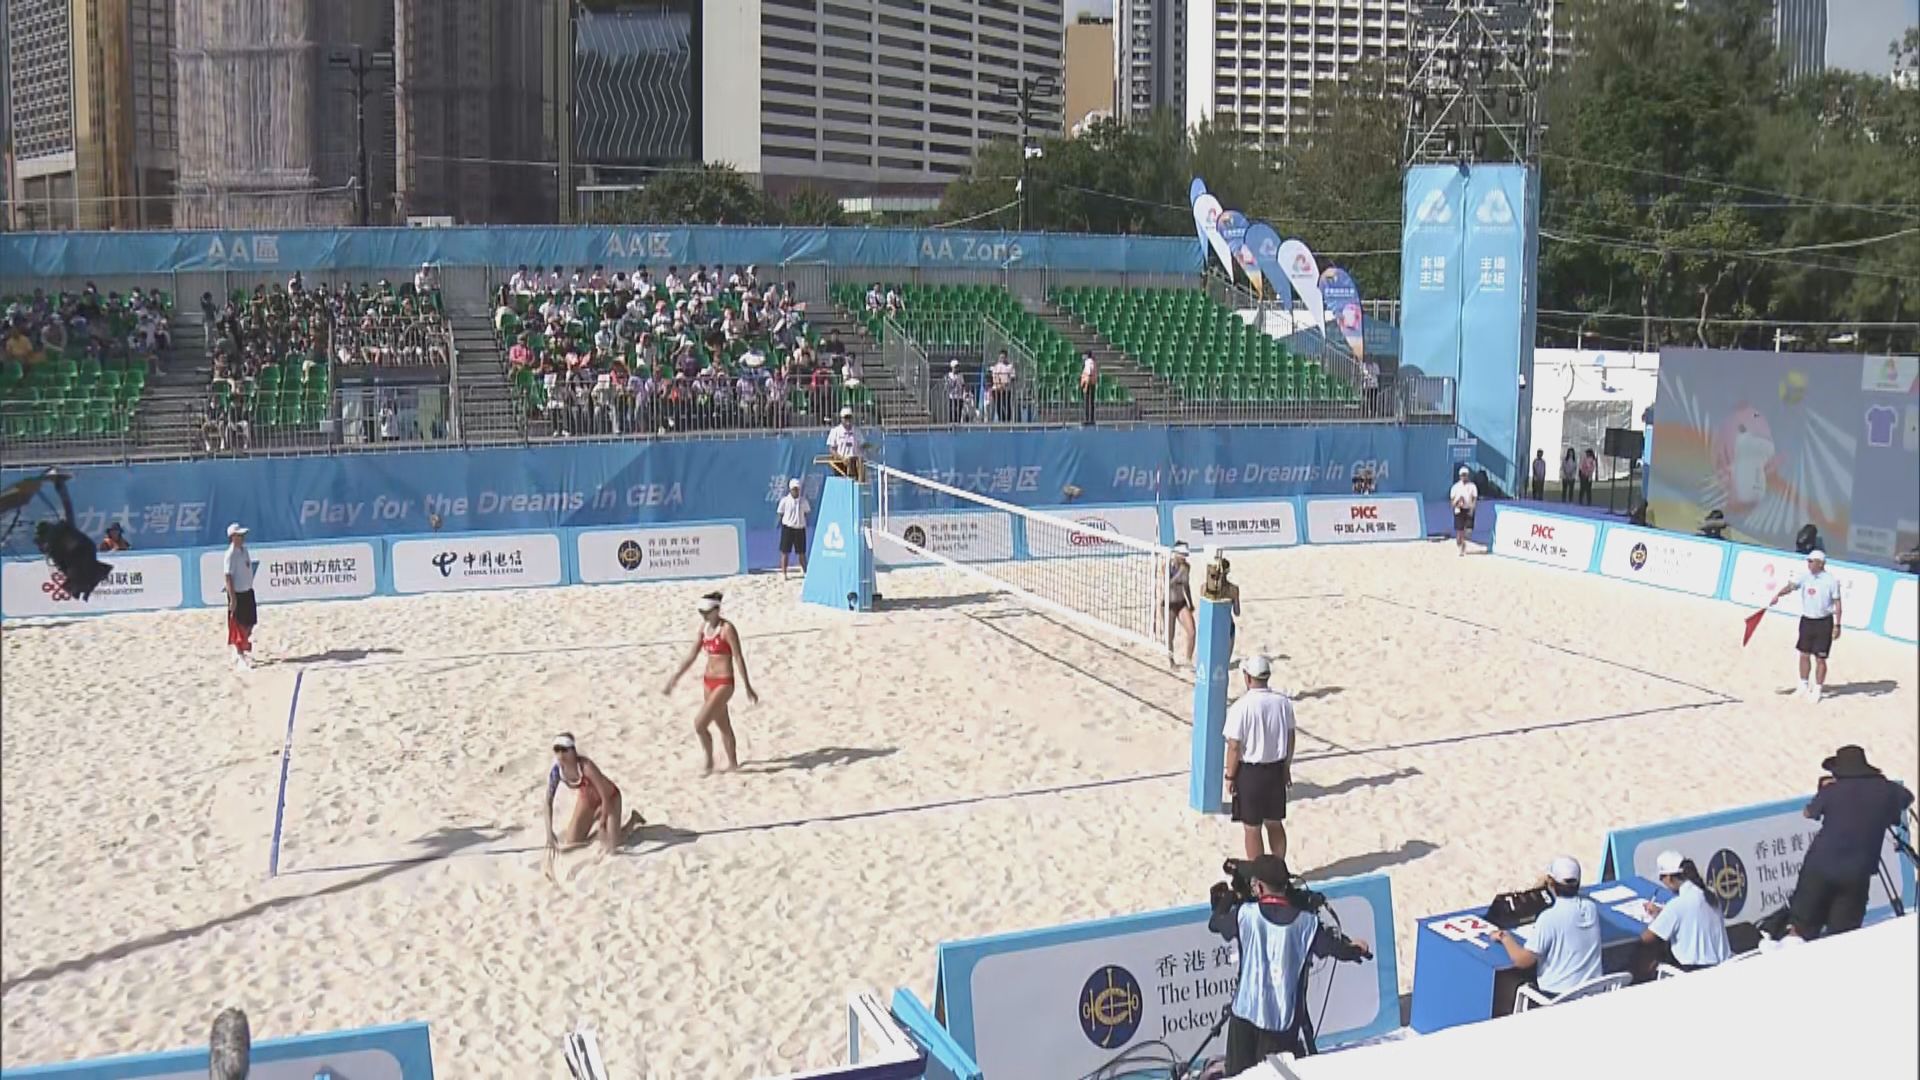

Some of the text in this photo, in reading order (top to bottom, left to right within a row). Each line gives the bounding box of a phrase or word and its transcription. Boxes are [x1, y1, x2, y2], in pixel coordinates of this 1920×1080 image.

[921, 236, 1023, 261] AA Zone
[1112, 465, 1159, 491] Play
[1204, 463, 1238, 486] the
[1243, 462, 1321, 483] Dreams
[1326, 459, 1345, 481] in
[300, 480, 684, 528] Play for the Dreams in GBA
[1351, 506, 1378, 520] PICC
[1530, 523, 1556, 540] PICC
[270, 557, 357, 577] 中国南方航空
[270, 573, 358, 588] CHINA SOUTHERN
[1755, 860, 1804, 883] The Hon
[1156, 945, 1234, 978] 香港賽
[1157, 978, 1239, 1005] The Hong
[1160, 1008, 1218, 1041] Jockey
